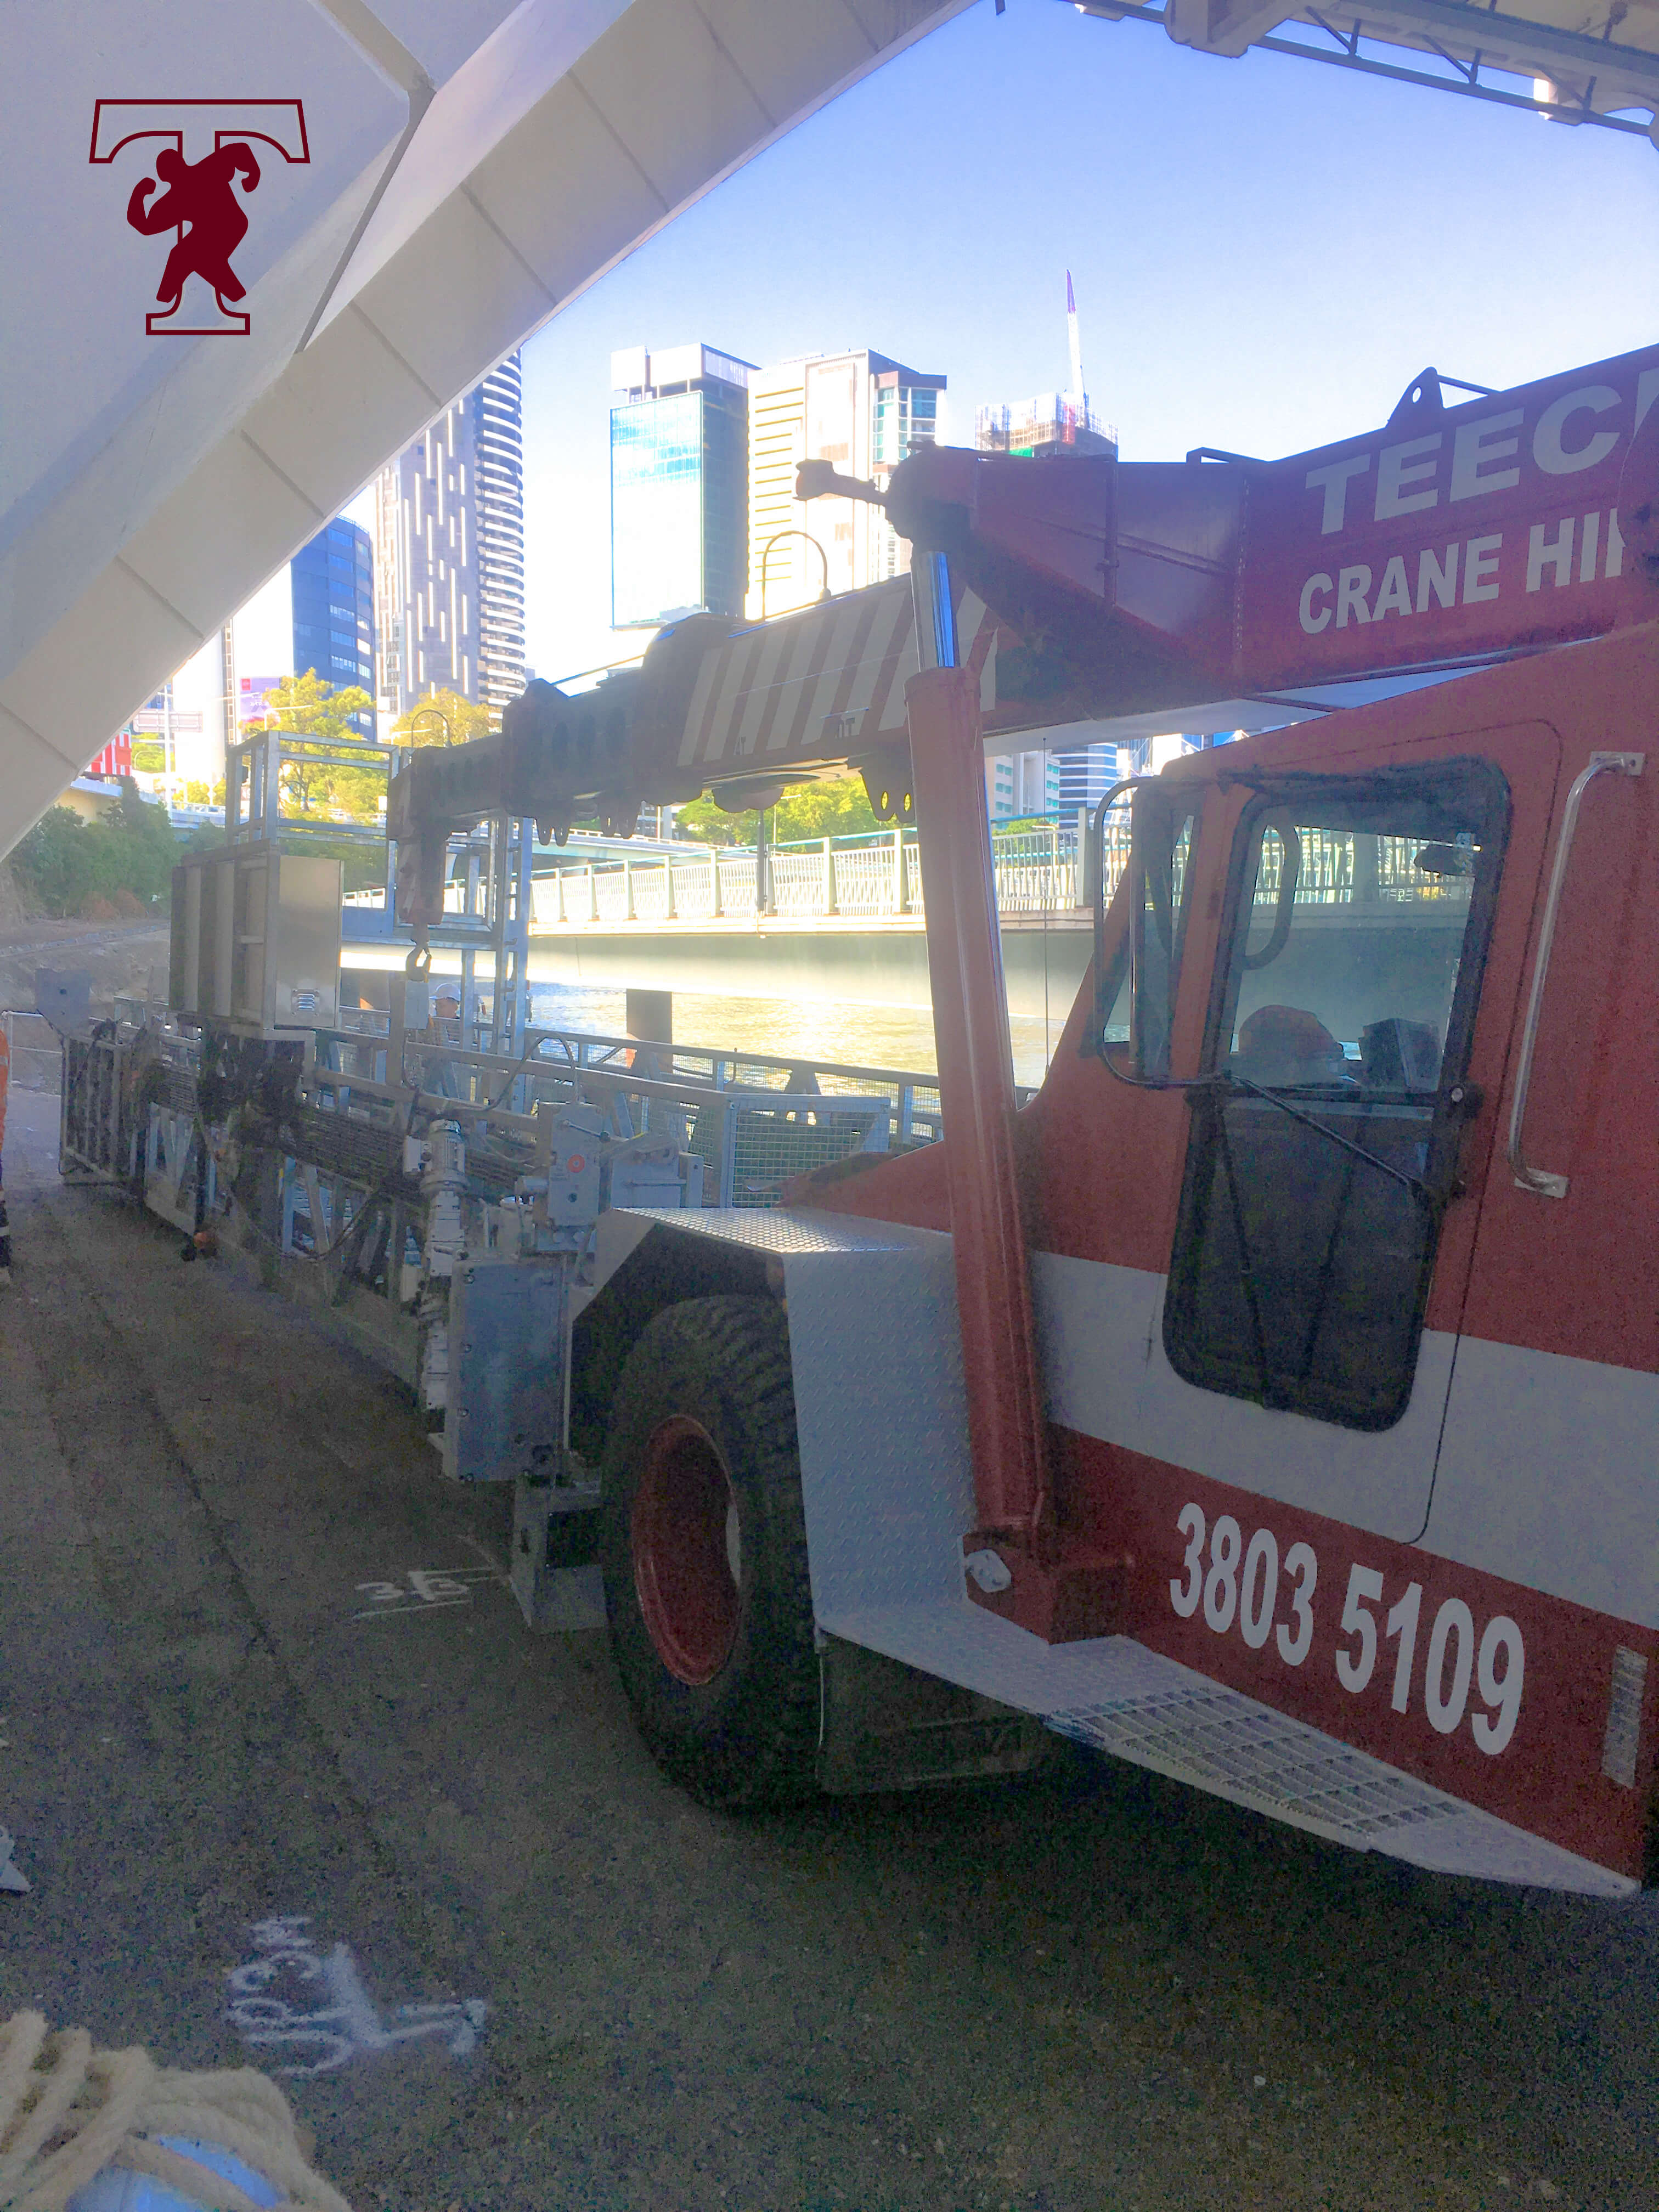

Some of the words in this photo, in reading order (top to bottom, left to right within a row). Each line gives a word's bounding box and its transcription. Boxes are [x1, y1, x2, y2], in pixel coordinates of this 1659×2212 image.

[1299, 533, 1504, 635] CRANE
[1169, 1502, 1318, 1667] 3803
[1335, 1562, 1525, 1755] 5109
